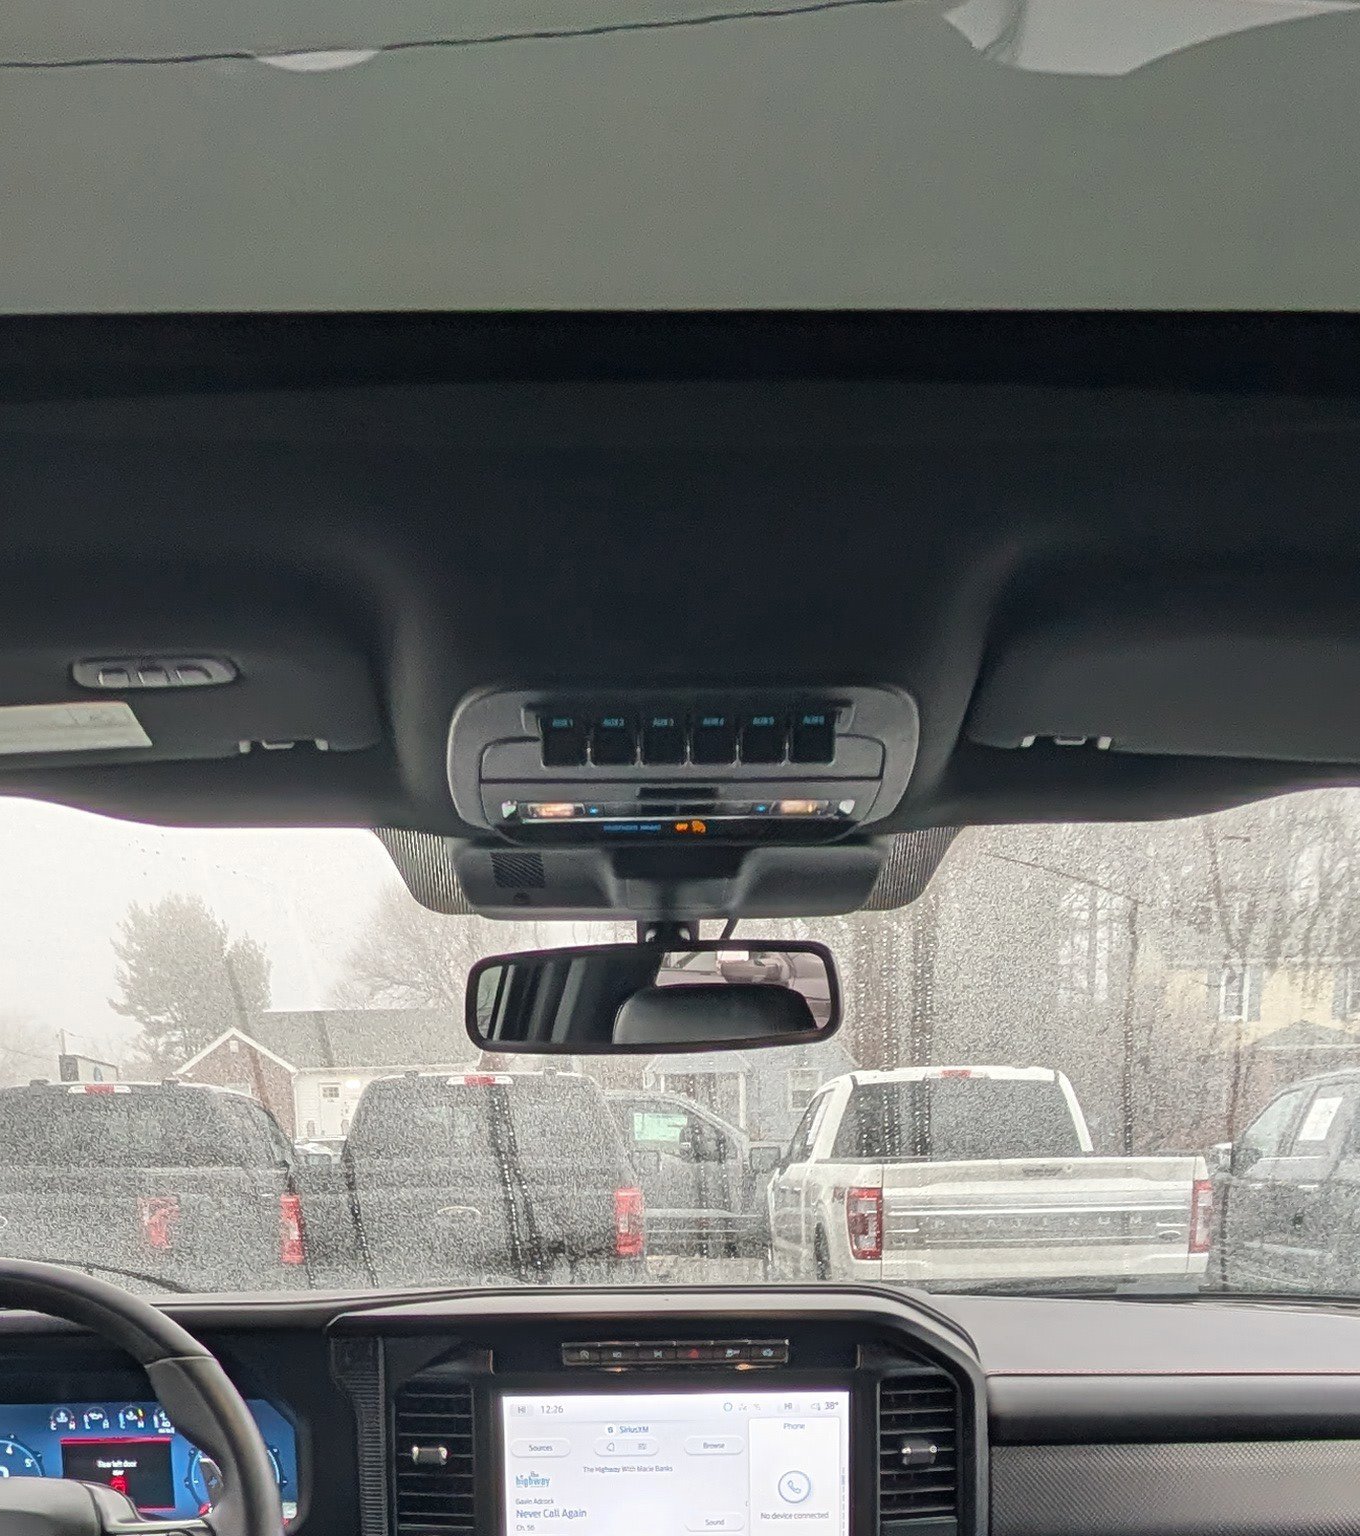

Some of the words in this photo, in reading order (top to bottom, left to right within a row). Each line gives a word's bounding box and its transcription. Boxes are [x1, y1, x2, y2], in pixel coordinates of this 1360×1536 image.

[931, 1213, 1144, 1231] PLATINUM
[540, 1405, 564, 1415] 12:26
[619, 1425, 650, 1435] SiriusXM
[783, 1422, 805, 1430] Phone
[528, 1443, 554, 1452] Sources
[703, 1441, 726, 1450] Browse
[516, 1510, 541, 1519] Never
[543, 1509, 560, 1518] Call
[562, 1508, 587, 1520] Again
[760, 1512, 772, 1520] No
[773, 1512, 792, 1520] device
[794, 1511, 830, 1520] connected
[705, 1518, 726, 1527] Sound
